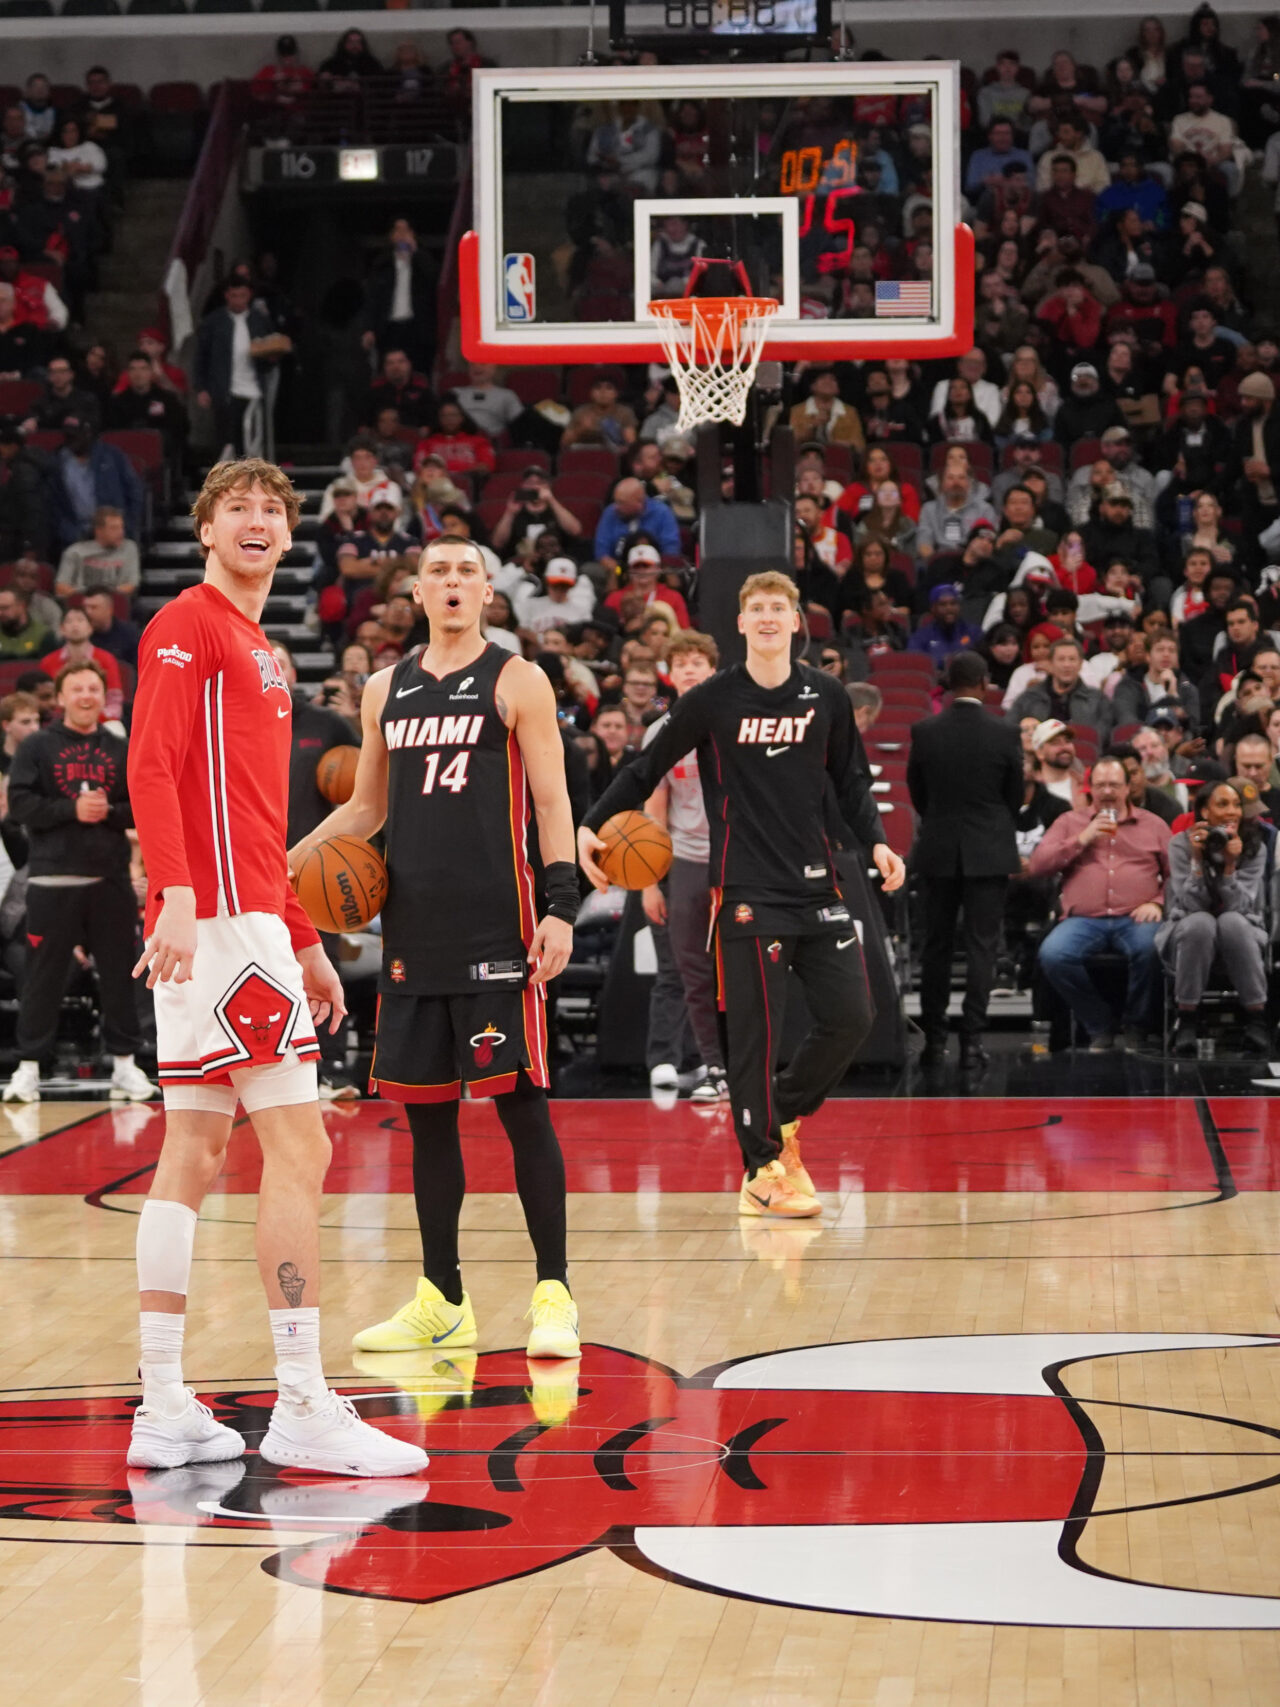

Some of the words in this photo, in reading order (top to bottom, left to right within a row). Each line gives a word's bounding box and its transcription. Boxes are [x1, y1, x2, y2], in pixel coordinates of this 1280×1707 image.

[281, 152, 316, 178] 116
[406, 150, 434, 174] 117
[384, 714, 486, 751] MIAMI
[737, 706, 816, 743] HEAT
[421, 749, 472, 796] 14
[335, 870, 363, 930] Wilson
